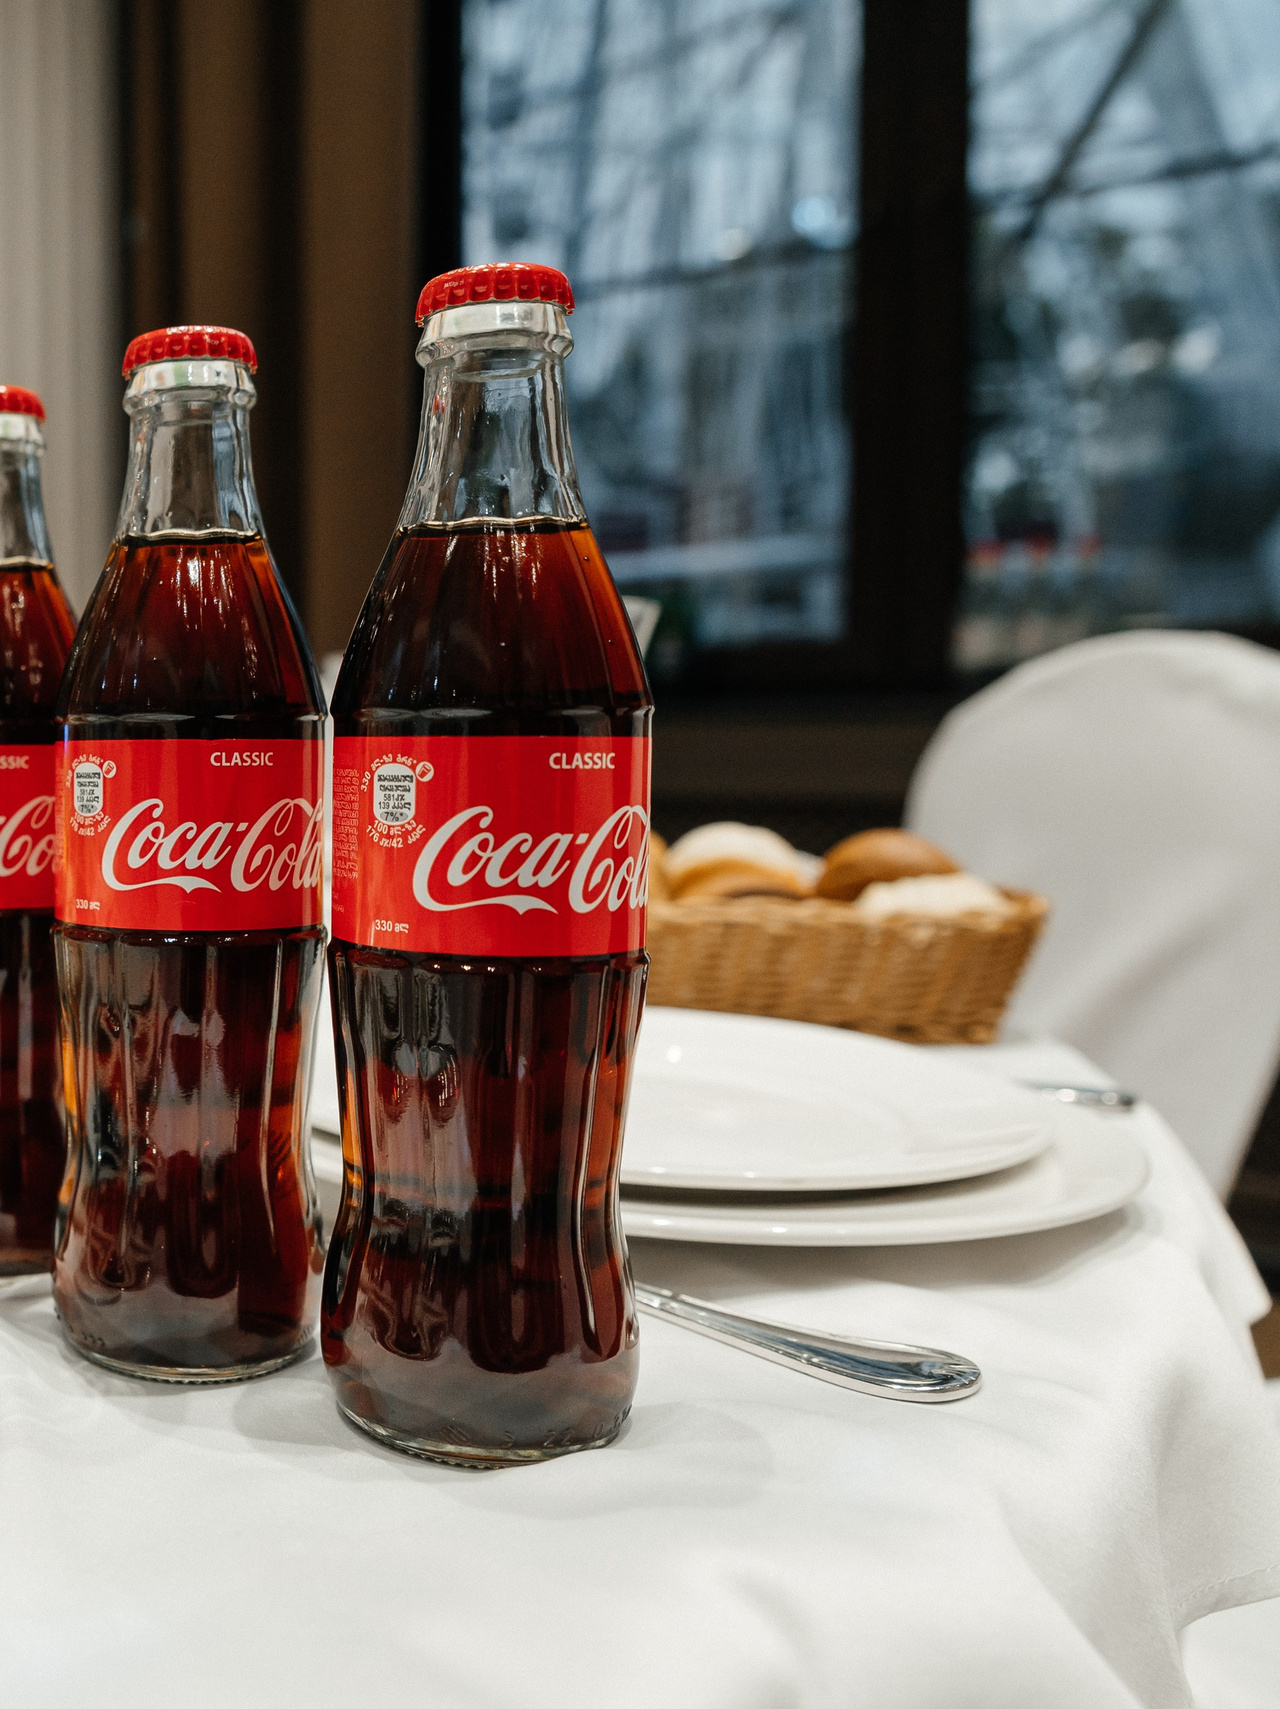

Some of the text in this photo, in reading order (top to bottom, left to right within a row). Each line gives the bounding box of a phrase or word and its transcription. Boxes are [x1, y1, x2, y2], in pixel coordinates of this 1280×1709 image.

[210, 752, 274, 767] CLASSIC
[549, 752, 616, 770] CLASSIC
[361, 771, 371, 792] 330
[378, 801, 390, 810] 139
[366, 825, 380, 842] 176
[373, 820, 388, 835] 100
[75, 898, 88, 910] 330
[375, 919, 409, 934] 330 მლ
